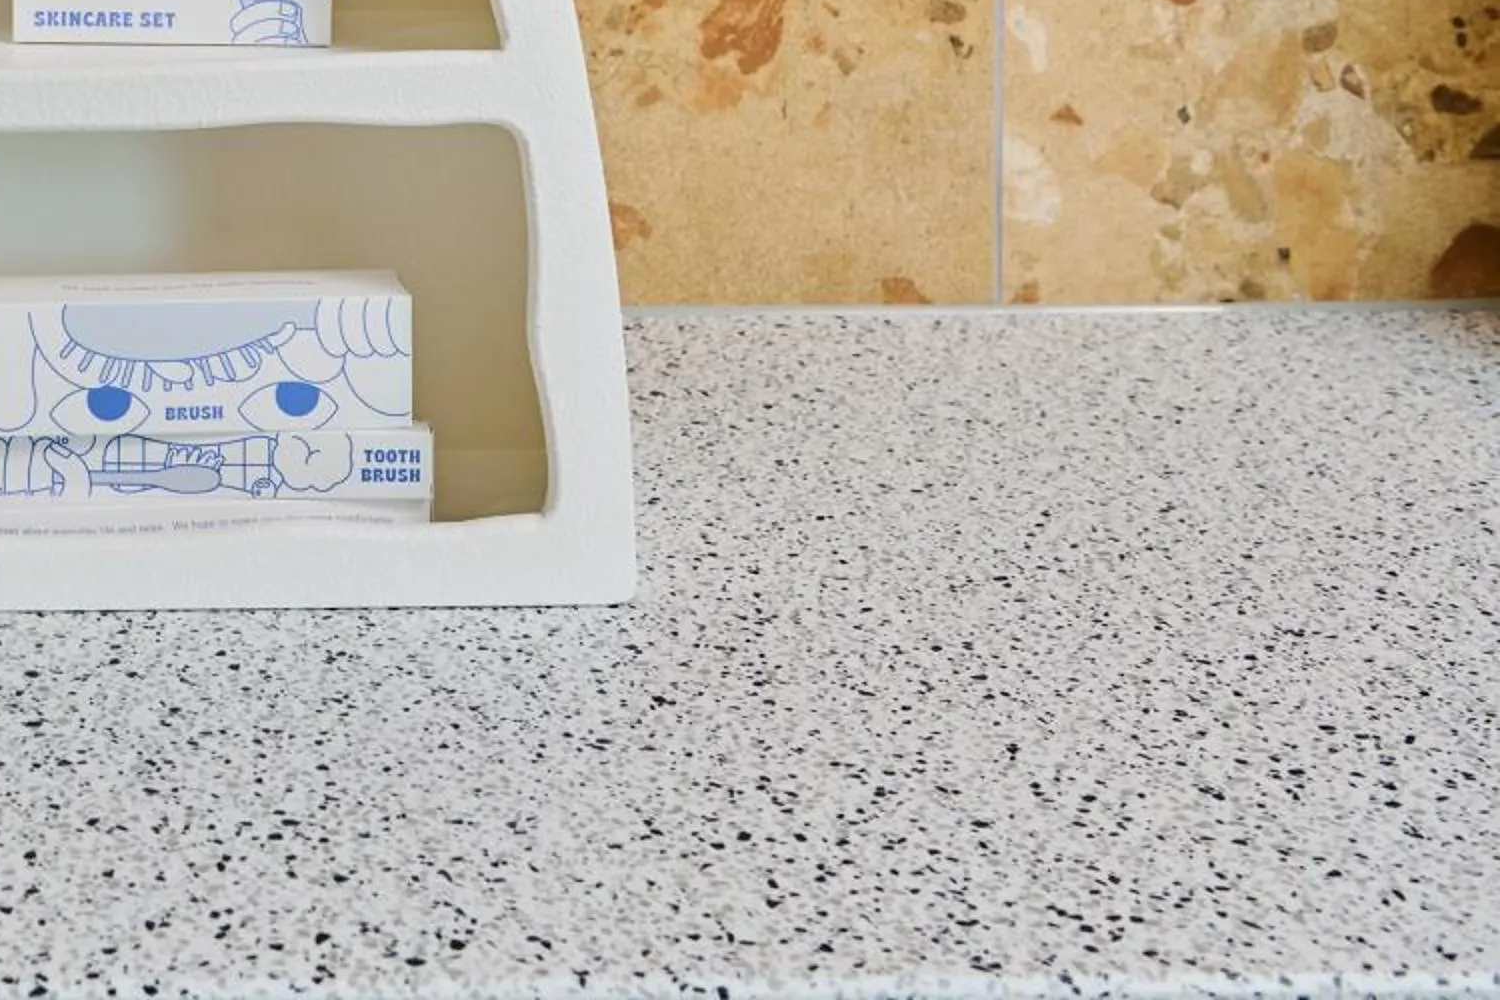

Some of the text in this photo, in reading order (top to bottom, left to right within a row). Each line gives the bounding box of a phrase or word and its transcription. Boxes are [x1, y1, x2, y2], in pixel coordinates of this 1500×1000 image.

[33, 10, 176, 29] SKINCARE SET
[164, 404, 225, 421] BRUSH
[364, 448, 421, 464] TOOTH
[361, 467, 421, 483] BRUSH
